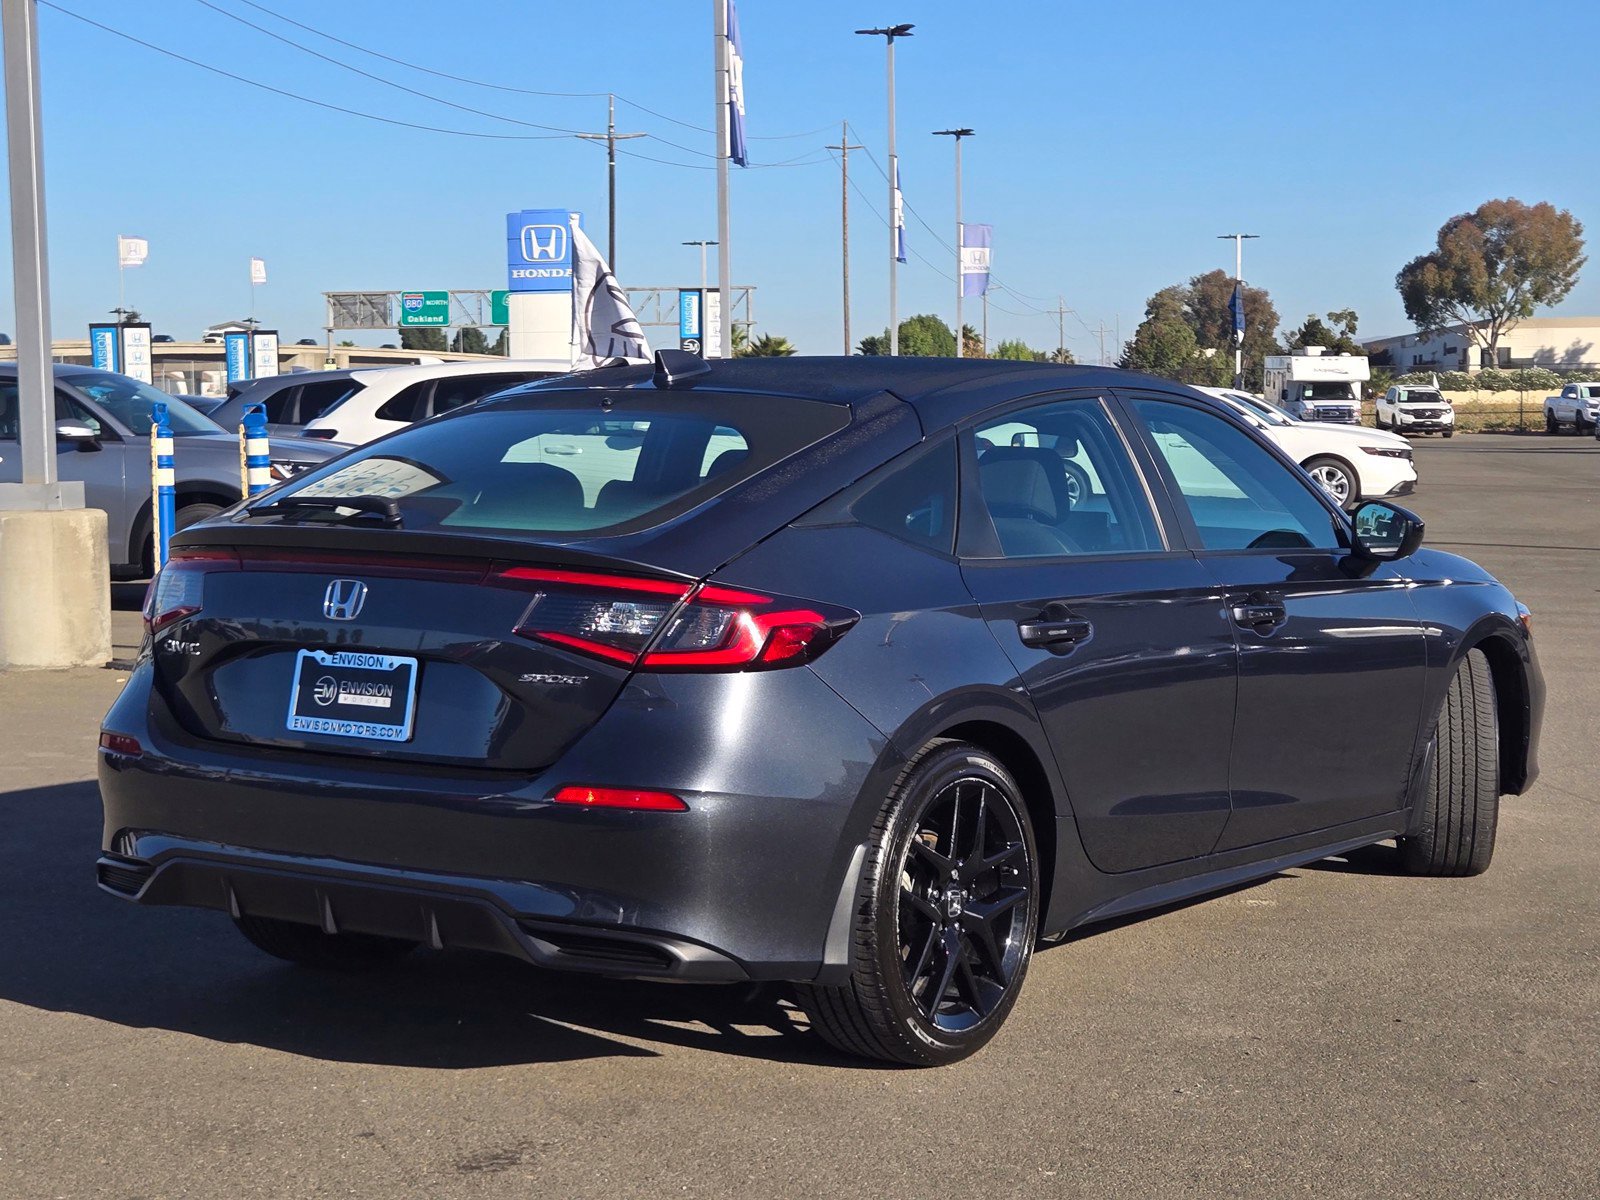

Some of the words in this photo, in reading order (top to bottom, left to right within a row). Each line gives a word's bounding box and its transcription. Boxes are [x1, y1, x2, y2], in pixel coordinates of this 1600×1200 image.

[407, 315, 444, 323] Oakland
[163, 639, 201, 656] CIVIC
[331, 653, 384, 668] ENVISION
[518, 673, 590, 685] SPORT
[339, 680, 393, 697] ENVISION
[342, 695, 388, 706] MOTORS
[293, 718, 403, 739] ENVISIONMOTORS.COM
